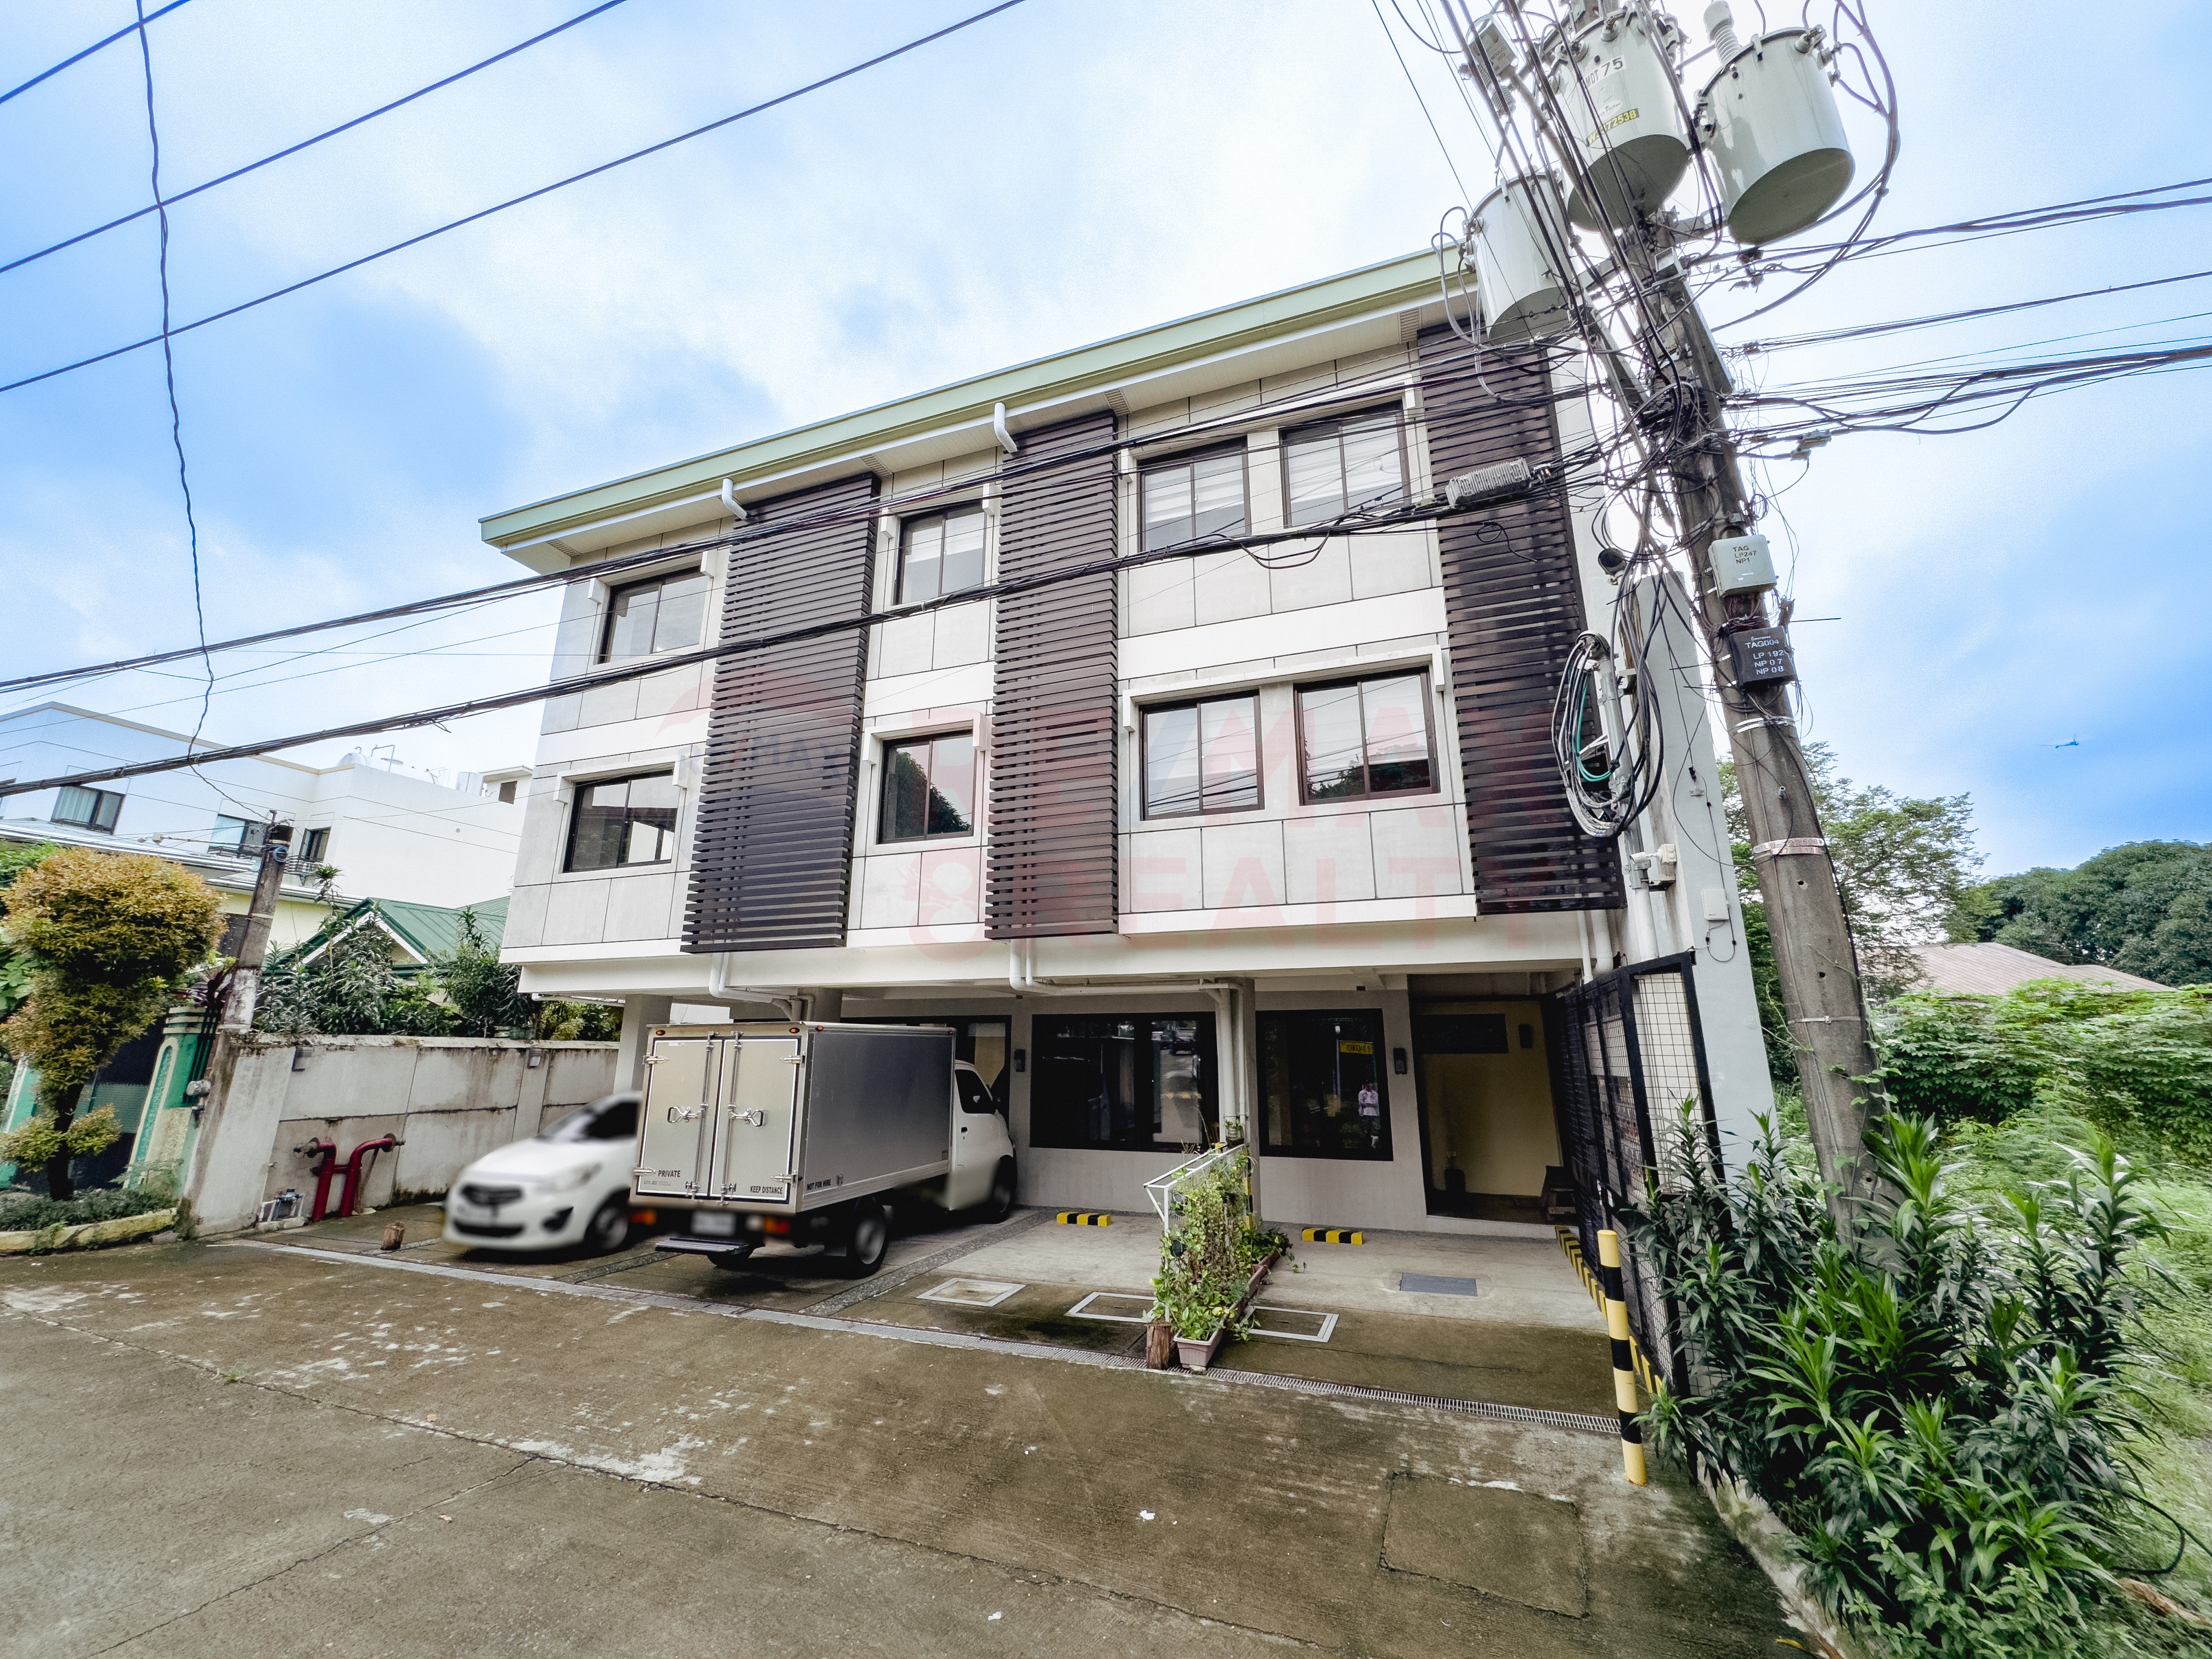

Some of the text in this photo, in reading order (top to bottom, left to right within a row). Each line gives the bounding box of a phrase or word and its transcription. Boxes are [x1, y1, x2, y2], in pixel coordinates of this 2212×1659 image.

[1601, 57, 1623, 77] 75
[1754, 660, 1767, 668] NP
[806, 1182, 815, 1190] NOT
[822, 1178, 832, 1187] HIRE
[762, 1186, 783, 1194] DISTANCE
